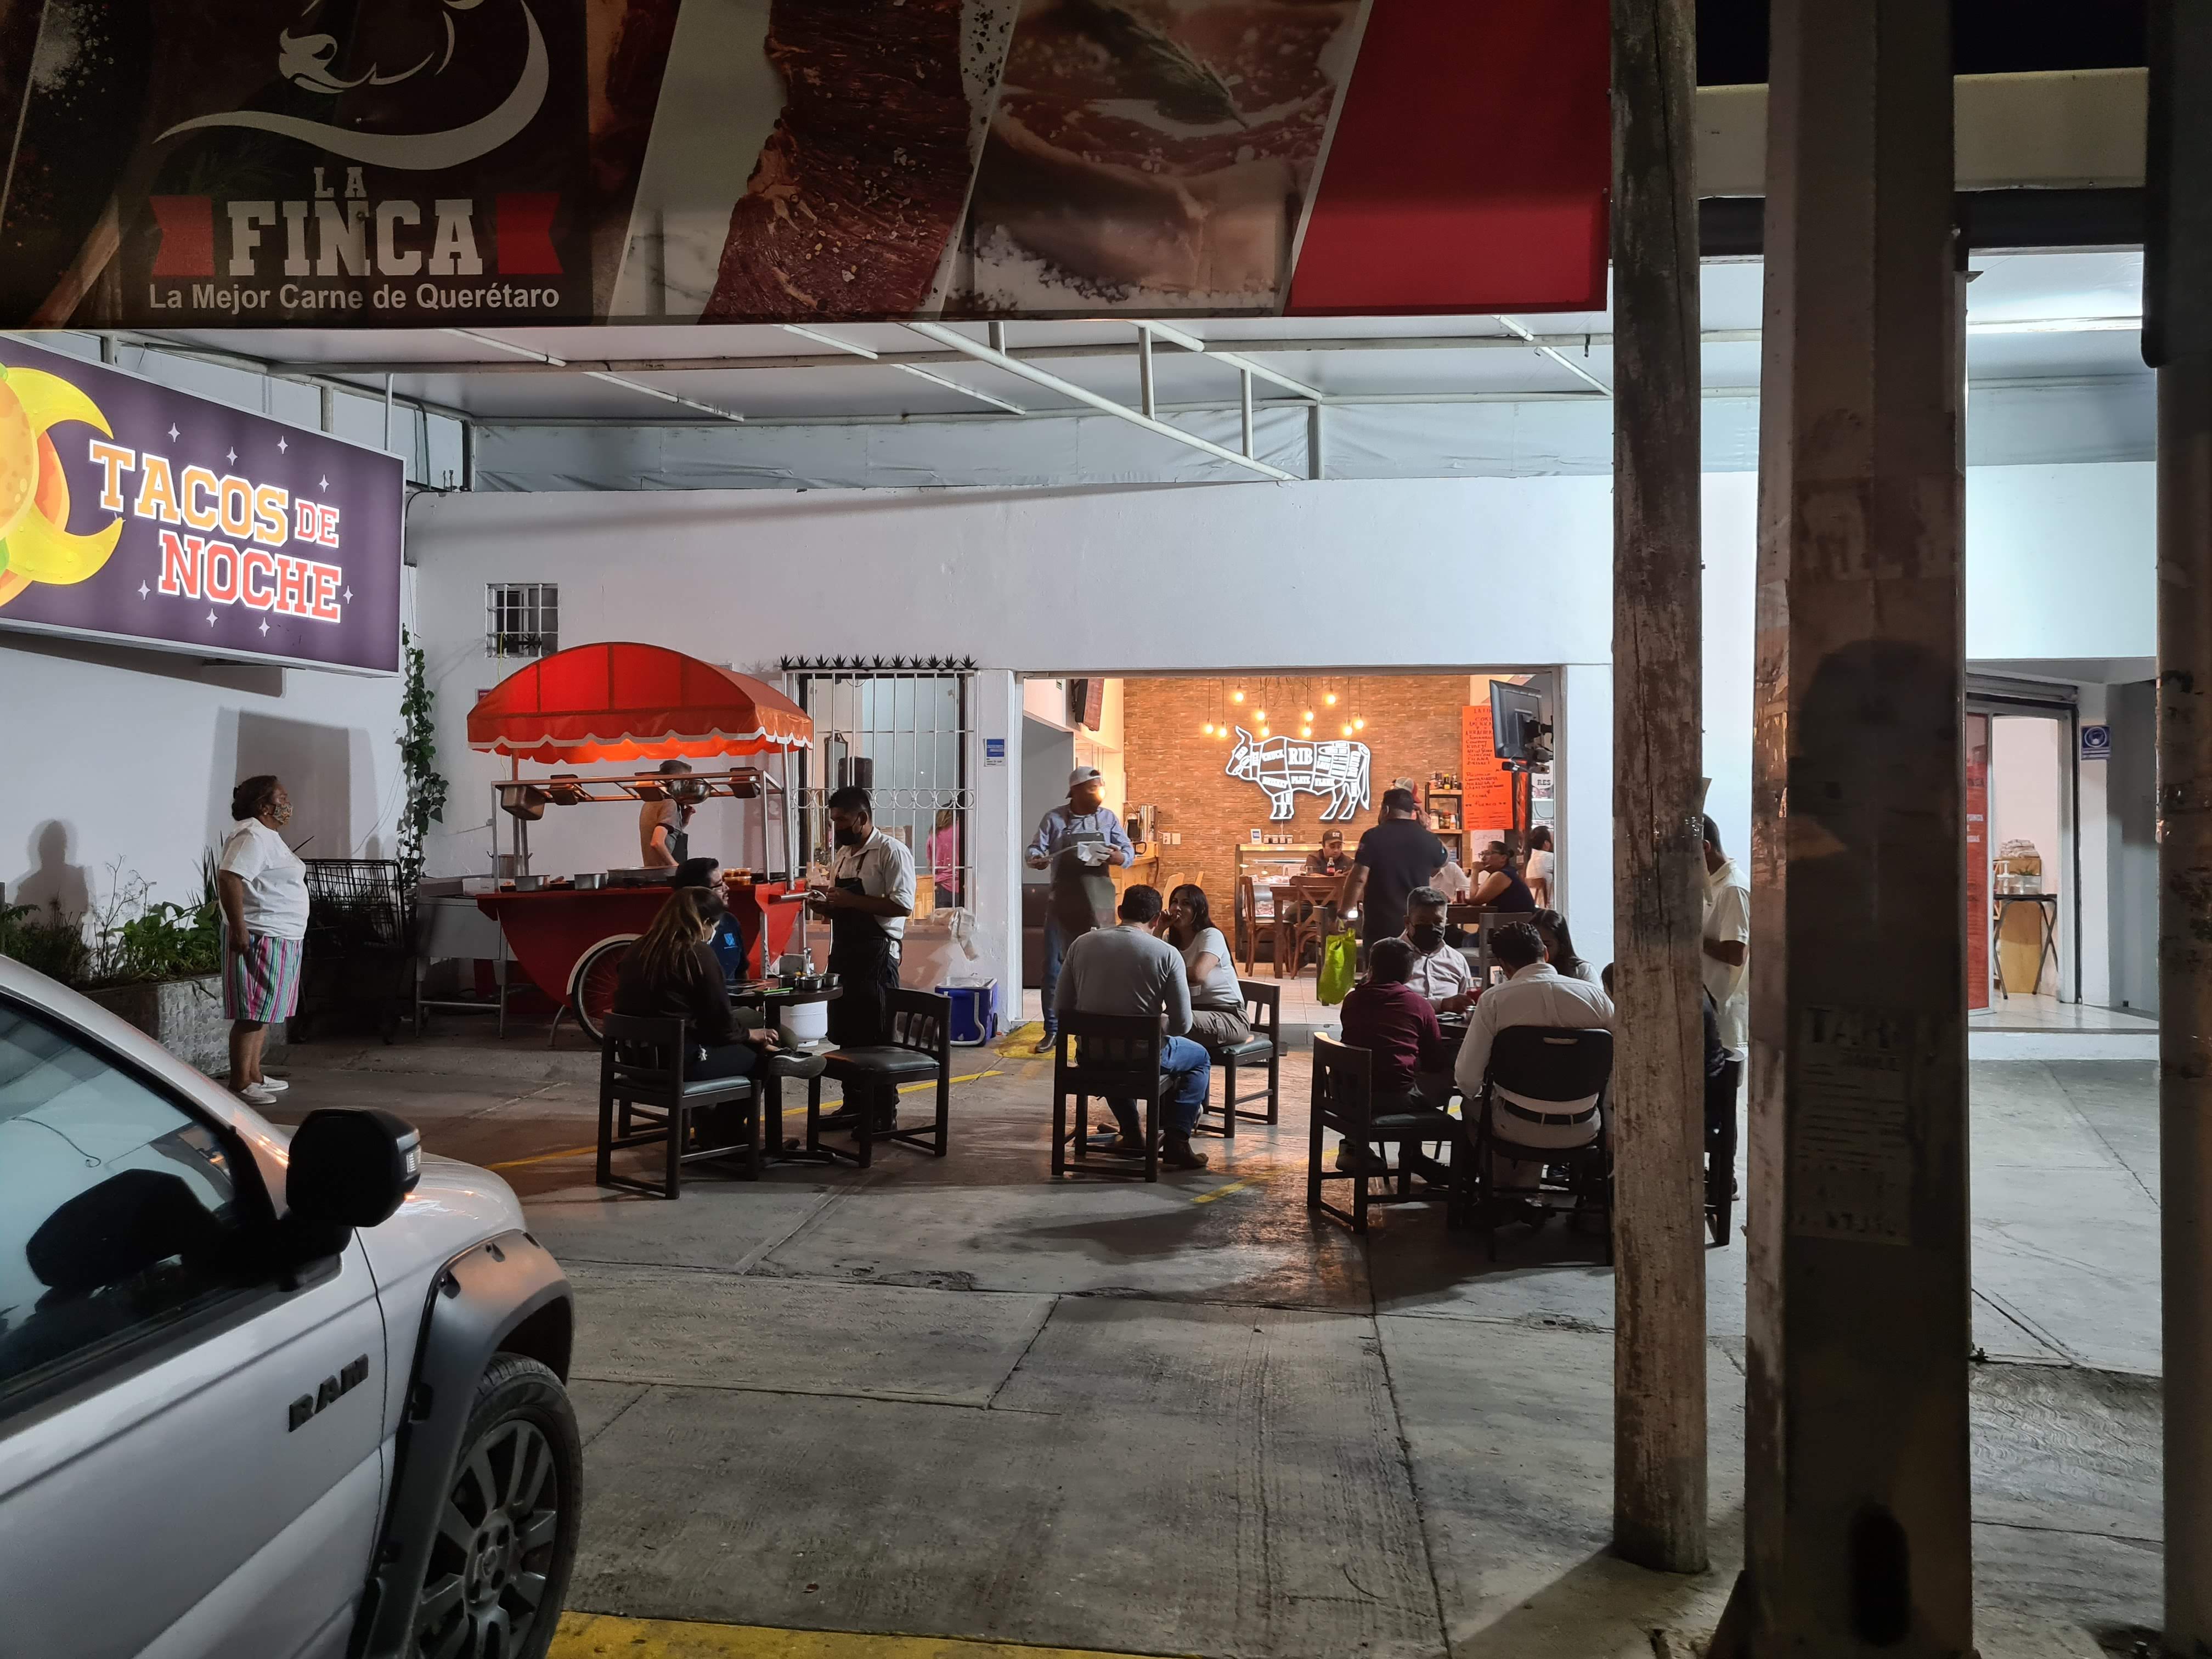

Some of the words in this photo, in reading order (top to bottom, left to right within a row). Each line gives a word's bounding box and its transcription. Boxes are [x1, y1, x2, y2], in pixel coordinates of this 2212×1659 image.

[314, 167, 367, 198] LA
[227, 199, 483, 276] FINCA
[150, 286, 183, 308] La
[193, 285, 270, 315] Mejor
[279, 284, 363, 309] Carne
[373, 284, 406, 309] de
[416, 281, 560, 309] Querétaro
[89, 439, 289, 547] TACOS
[295, 498, 340, 549] DE
[158, 530, 342, 623] NOCHE
[1288, 748, 1313, 765] RIB
[288, 1353, 369, 1433] RAM
